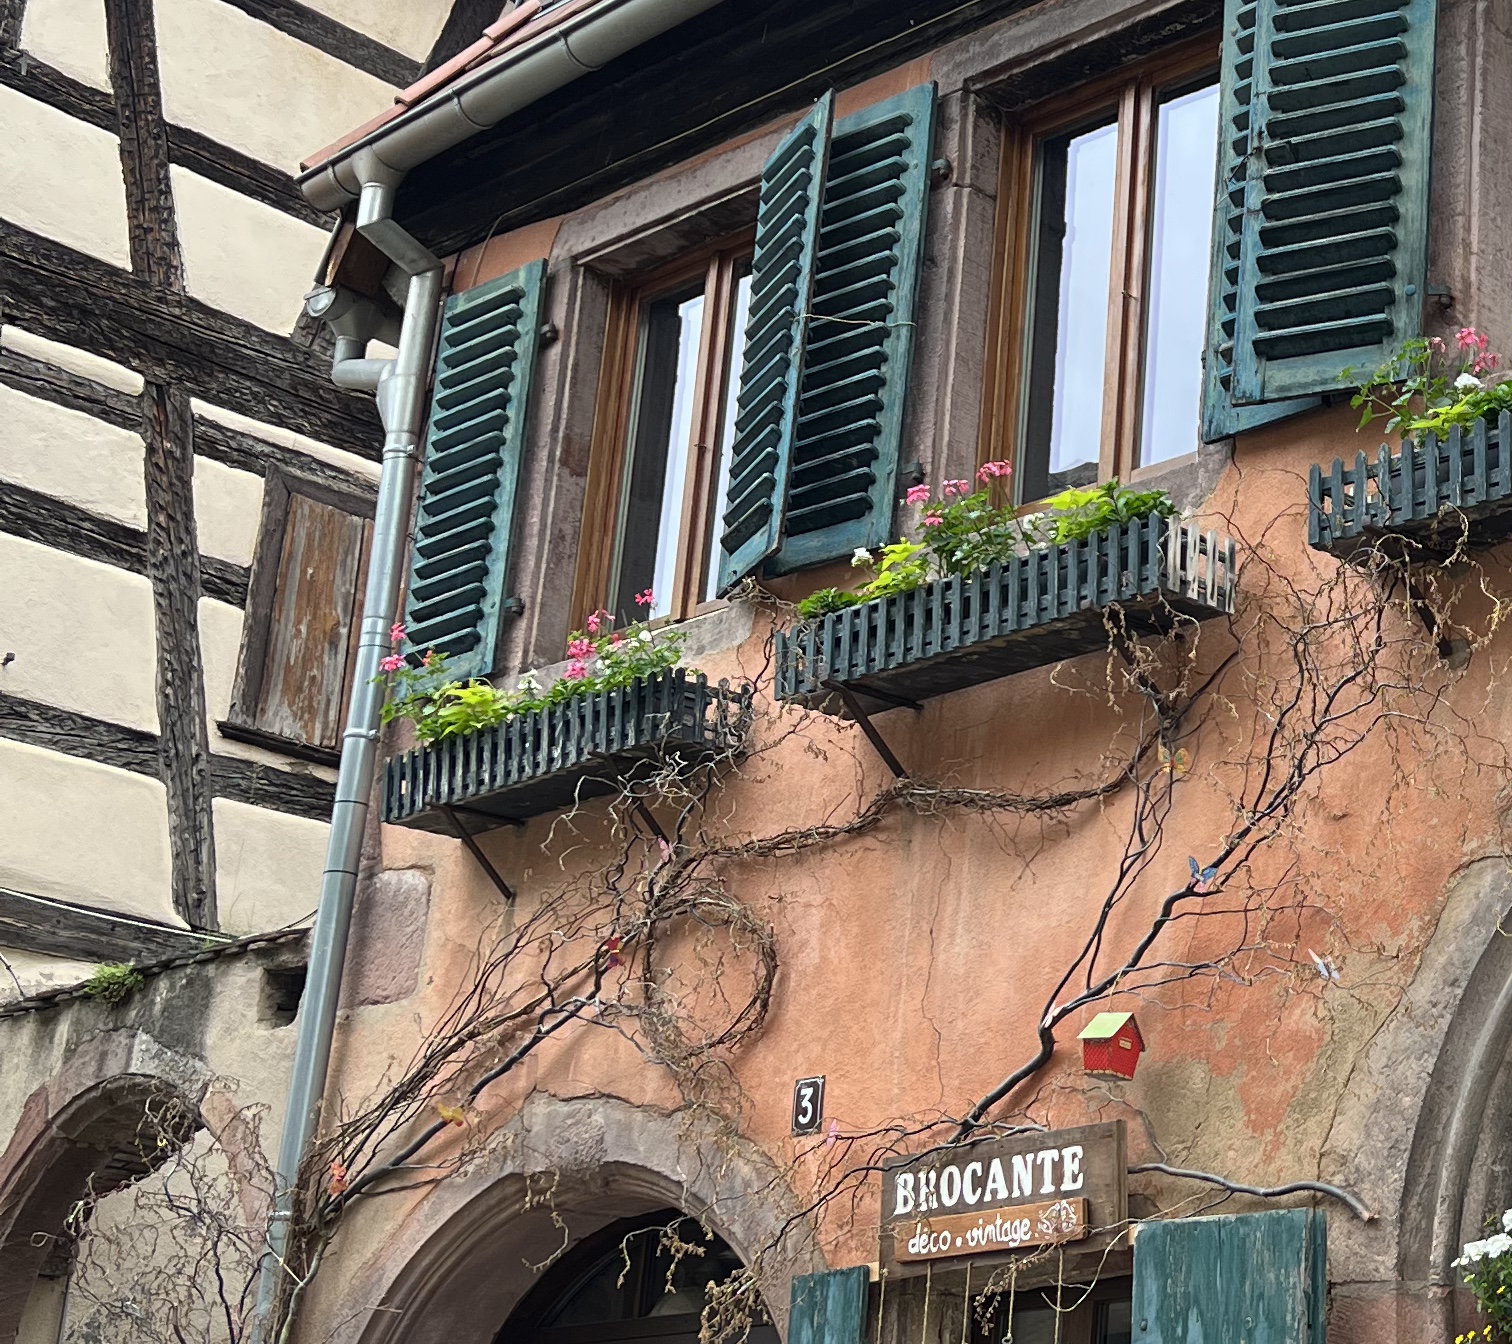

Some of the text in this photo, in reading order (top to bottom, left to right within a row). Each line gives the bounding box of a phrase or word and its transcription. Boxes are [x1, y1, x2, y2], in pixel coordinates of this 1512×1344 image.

[797, 1087, 814, 1124] 3
[893, 1145, 1084, 1216] BROCANTE
[965, 1213, 1031, 1247] vintage
